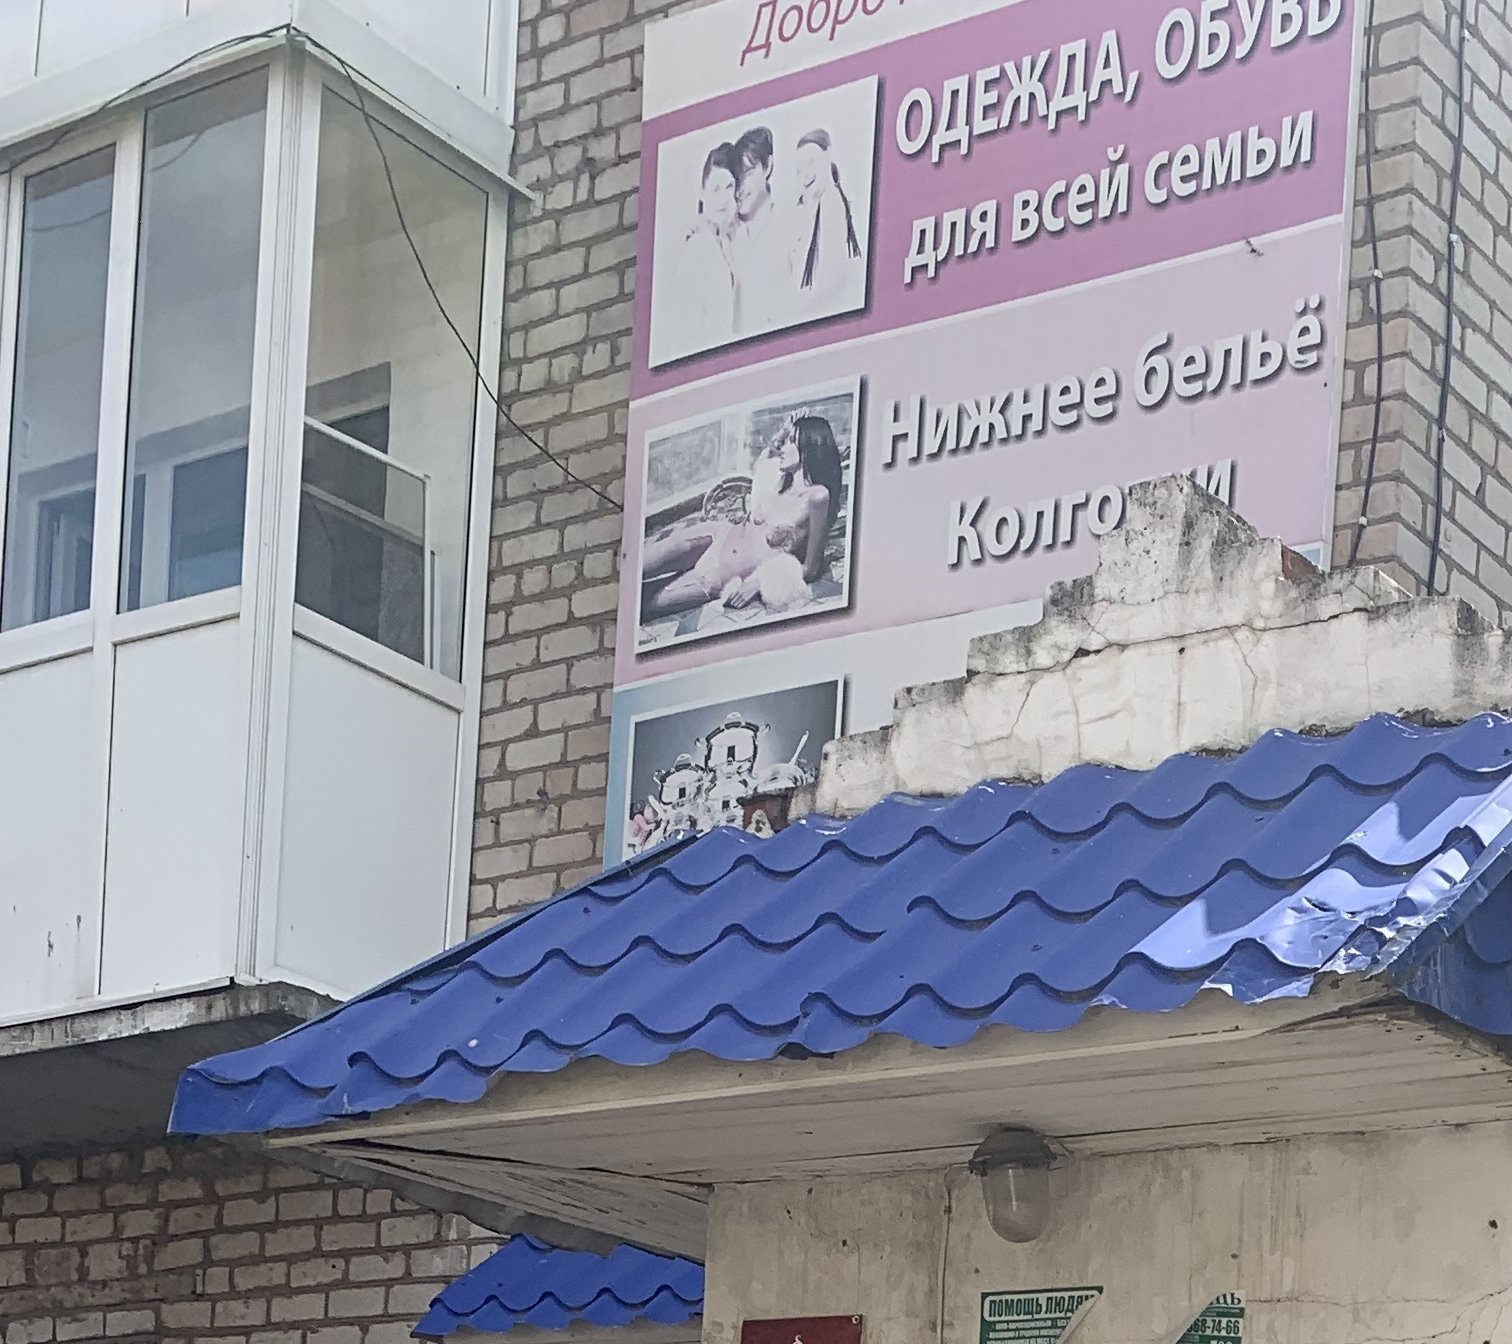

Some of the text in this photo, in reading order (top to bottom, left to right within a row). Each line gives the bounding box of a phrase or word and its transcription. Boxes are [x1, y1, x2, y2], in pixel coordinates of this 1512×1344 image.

[895, 28, 1140, 166] ОДЕЖДА,
[903, 110, 1314, 283] для всей семьи
[882, 294, 1323, 464] Нижнее бельё
[948, 458, 1232, 565] Колгои
[988, 1294, 1095, 1318] ПОМОЩЬ ЛЮДЯ
